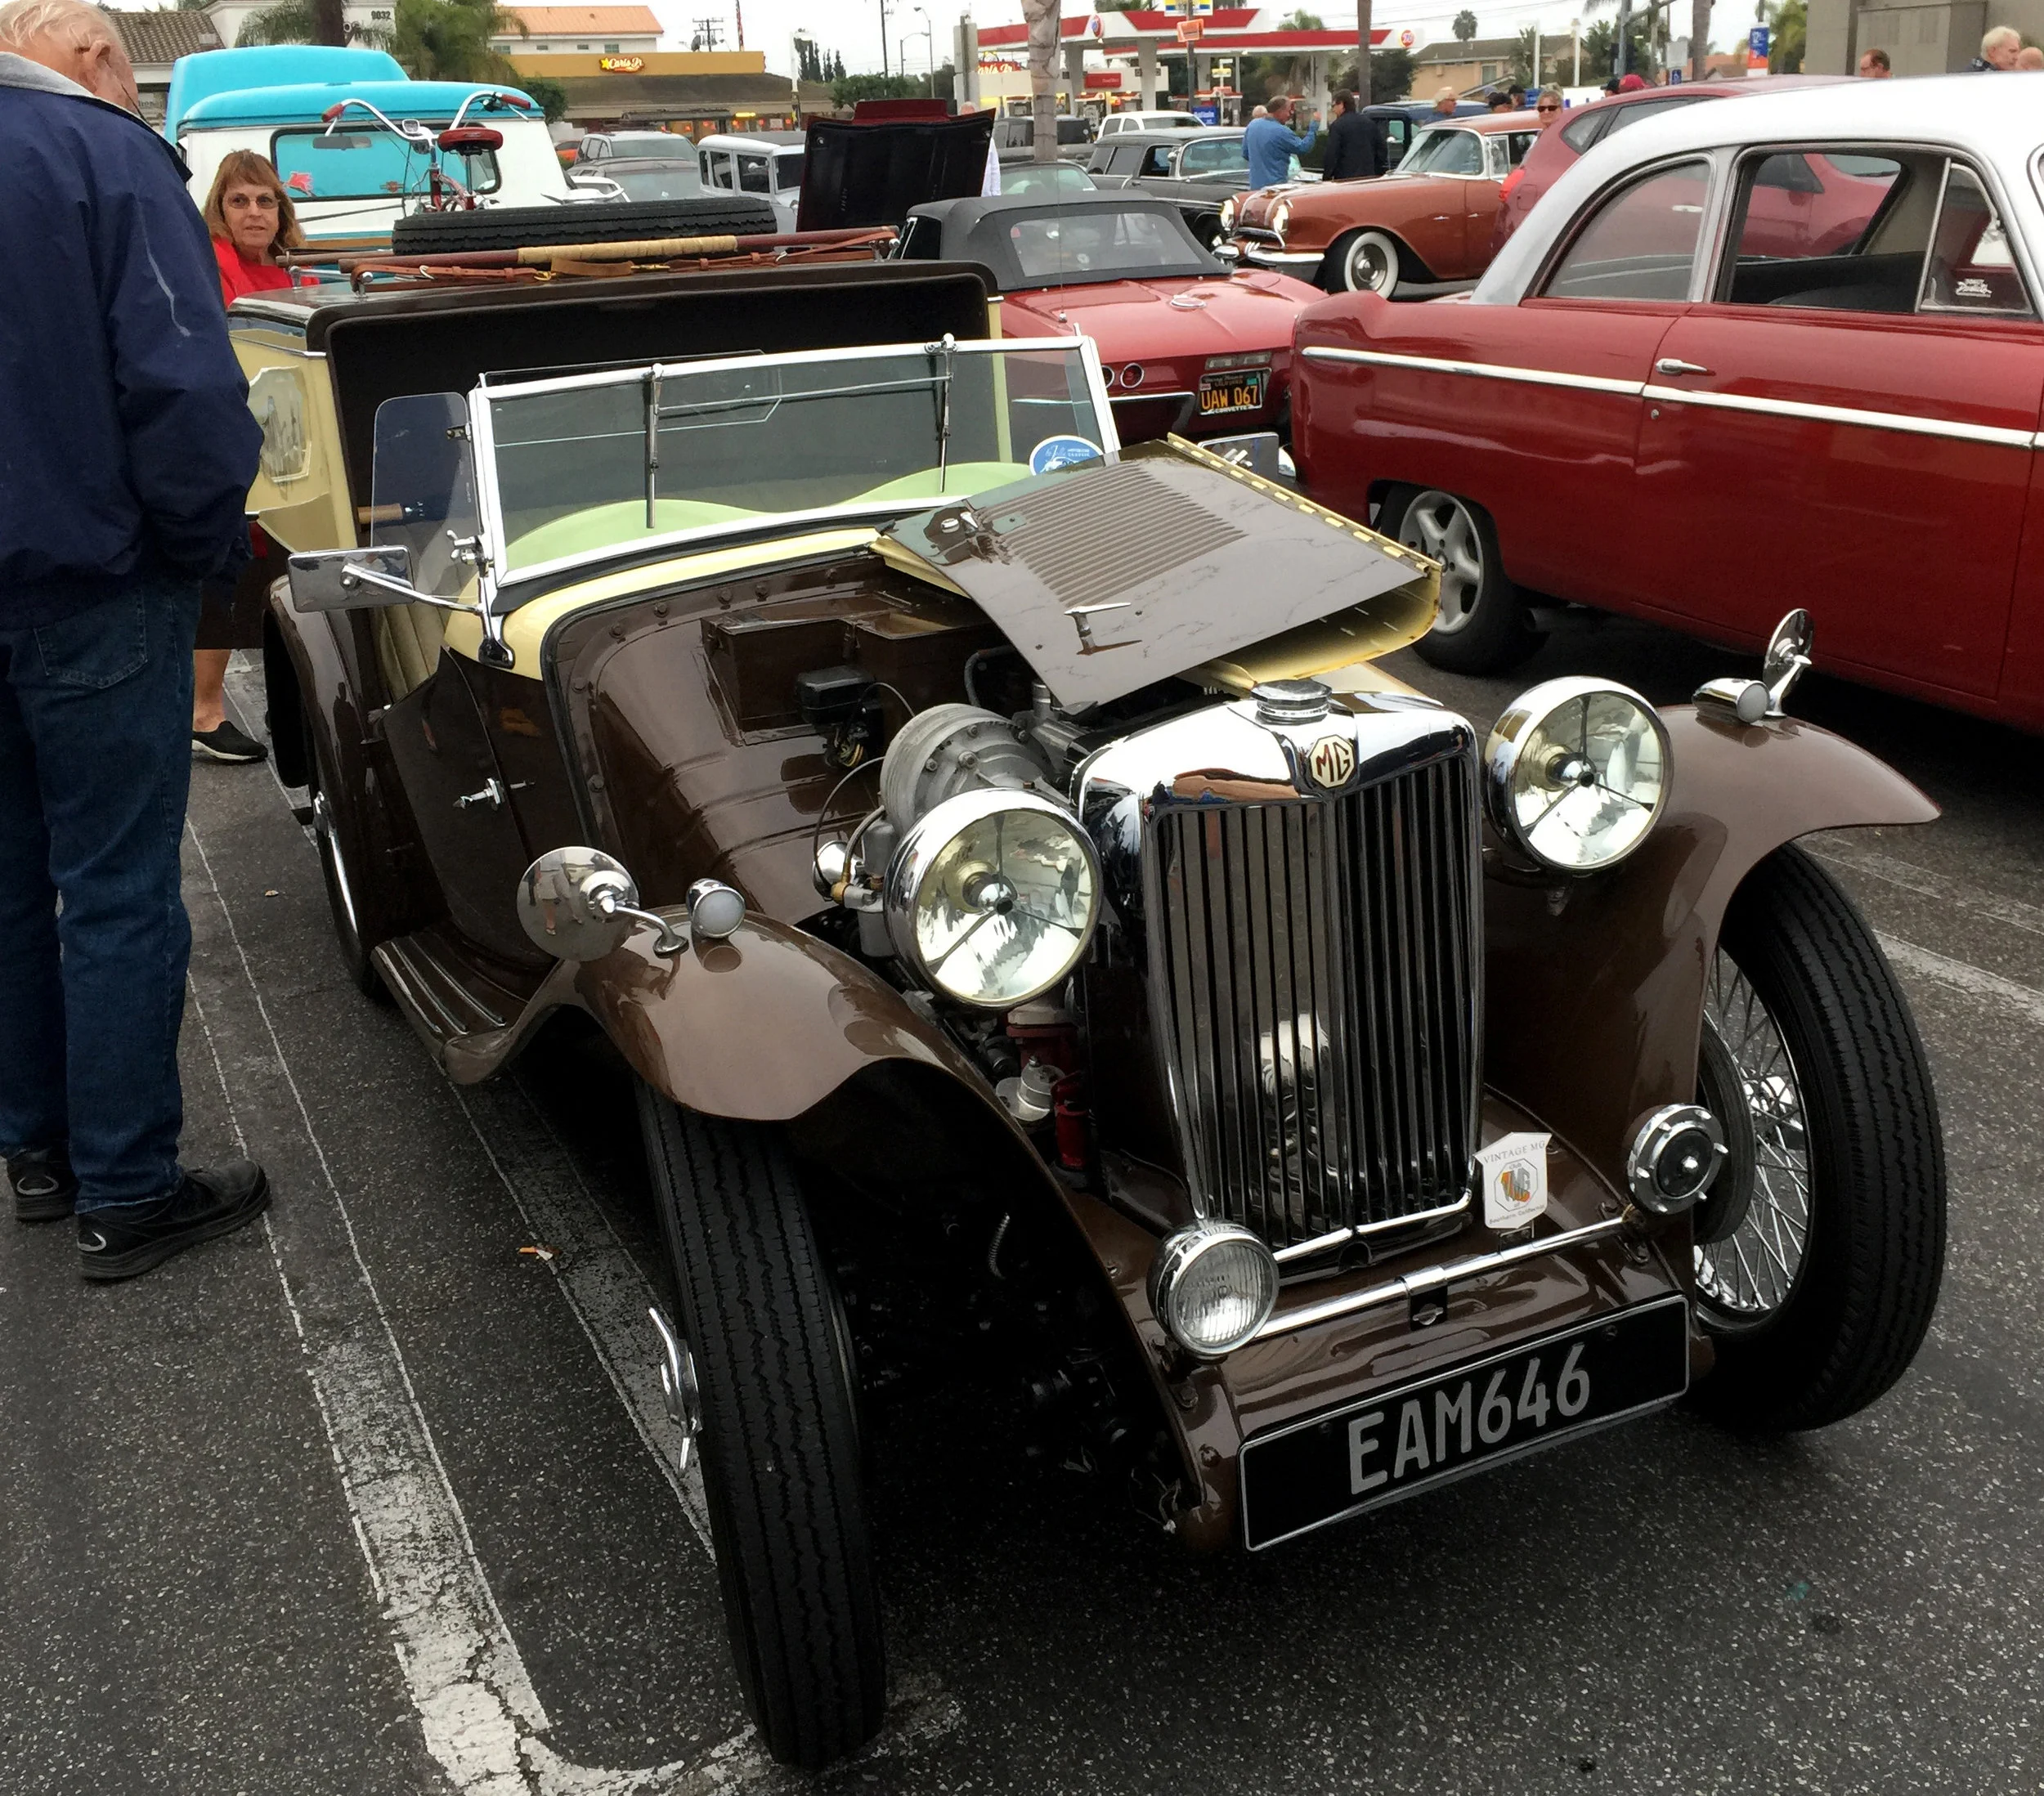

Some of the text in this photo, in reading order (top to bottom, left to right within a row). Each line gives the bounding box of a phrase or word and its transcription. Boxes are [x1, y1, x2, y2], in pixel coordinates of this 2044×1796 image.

[1201, 385, 1257, 410] UAW 067
[1316, 741, 1351, 782] MG
[1484, 1140, 1545, 1163] VINTAGE MG
[1348, 1343, 1590, 1495] EAM646
